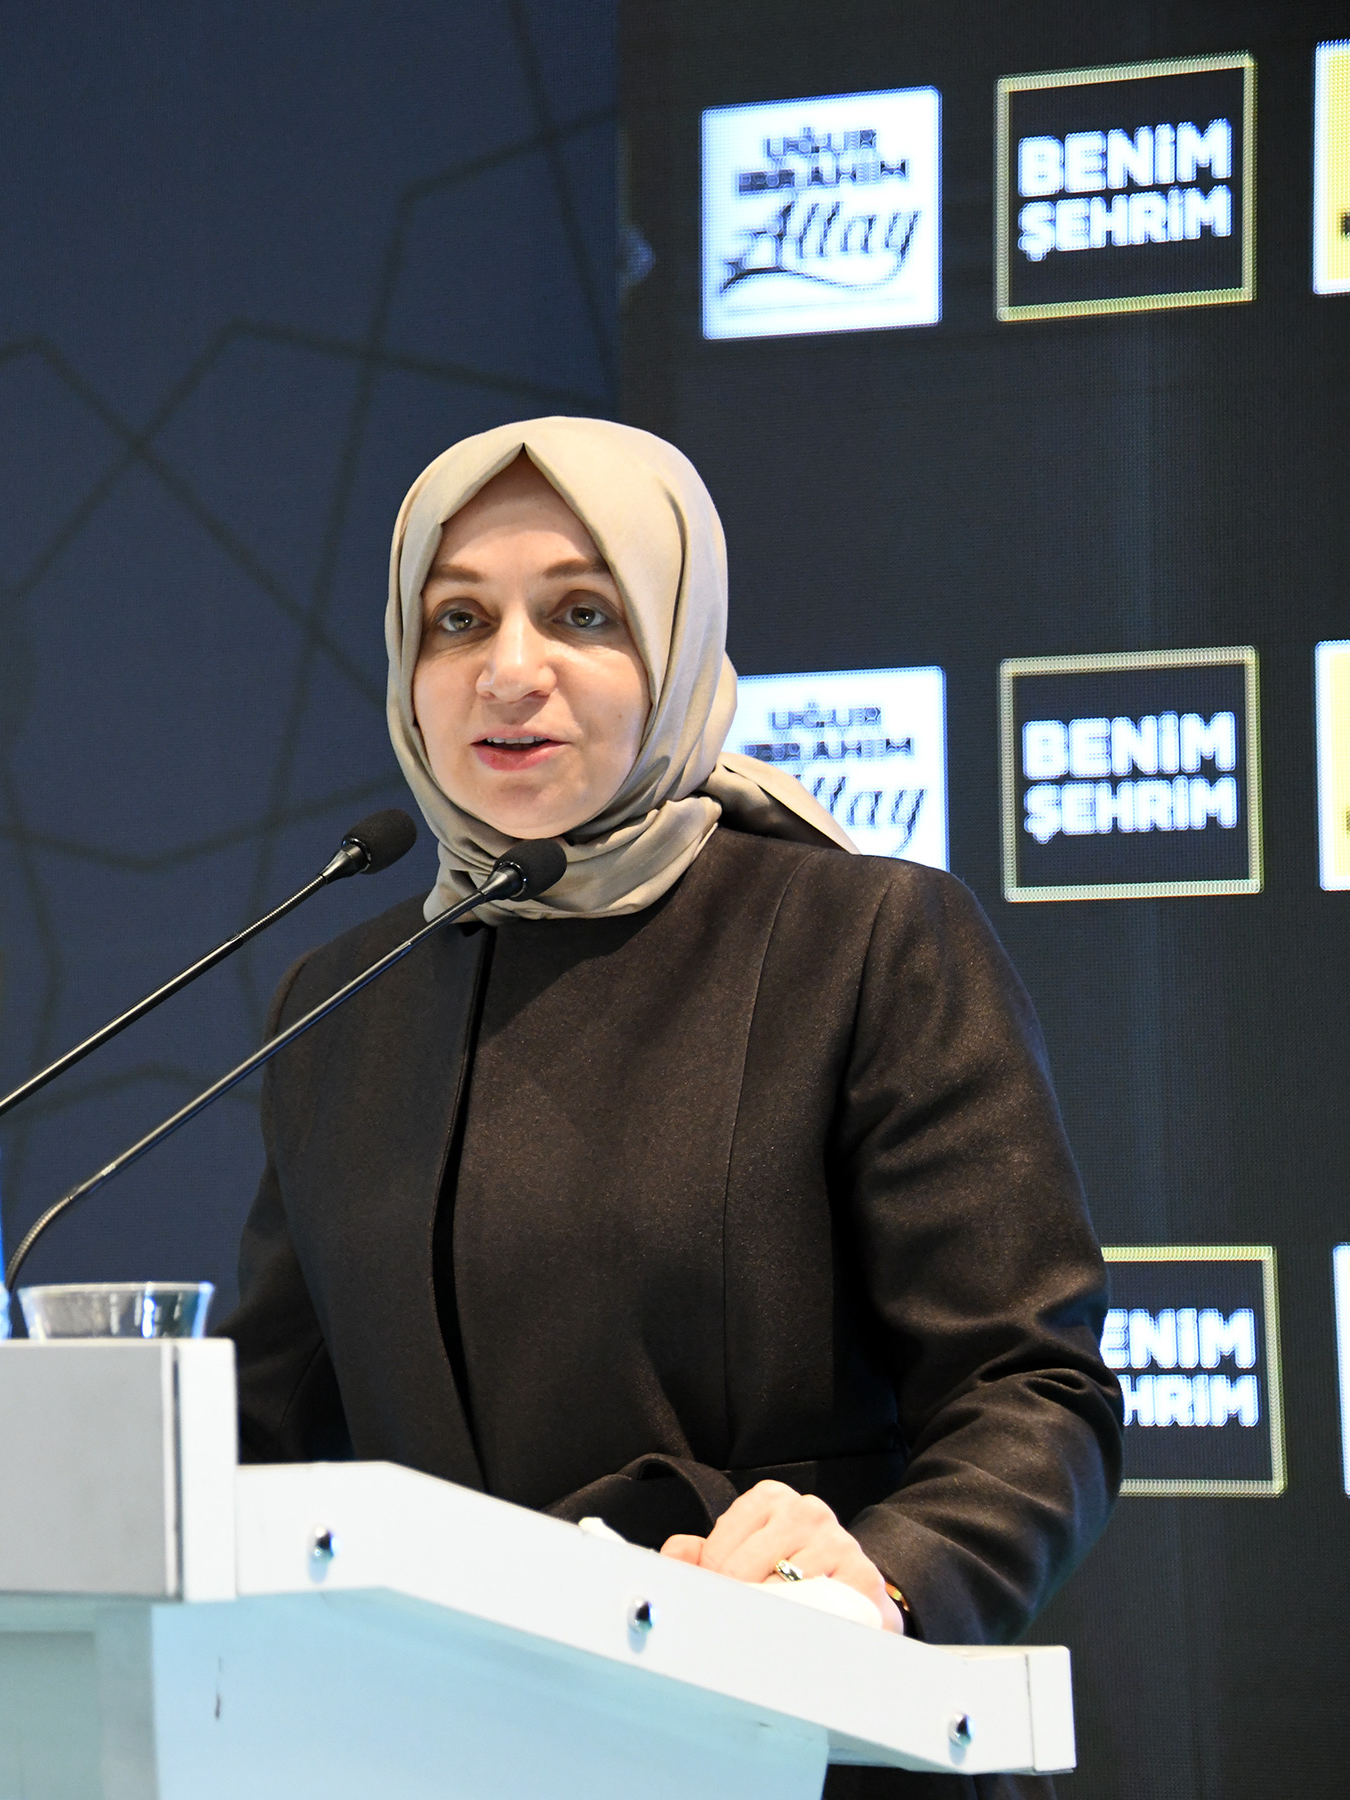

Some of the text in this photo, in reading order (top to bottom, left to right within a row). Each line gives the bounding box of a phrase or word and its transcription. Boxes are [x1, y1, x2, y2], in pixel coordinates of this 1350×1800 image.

[1017, 117, 1232, 198] BENİM
[1018, 184, 1232, 262] ŞEHRİM
[1022, 711, 1236, 780] BENİM
[1023, 775, 1238, 844] ŞEHRİM
[1100, 1308, 1256, 1369] ENİM
[1116, 1373, 1259, 1427] HRİM
